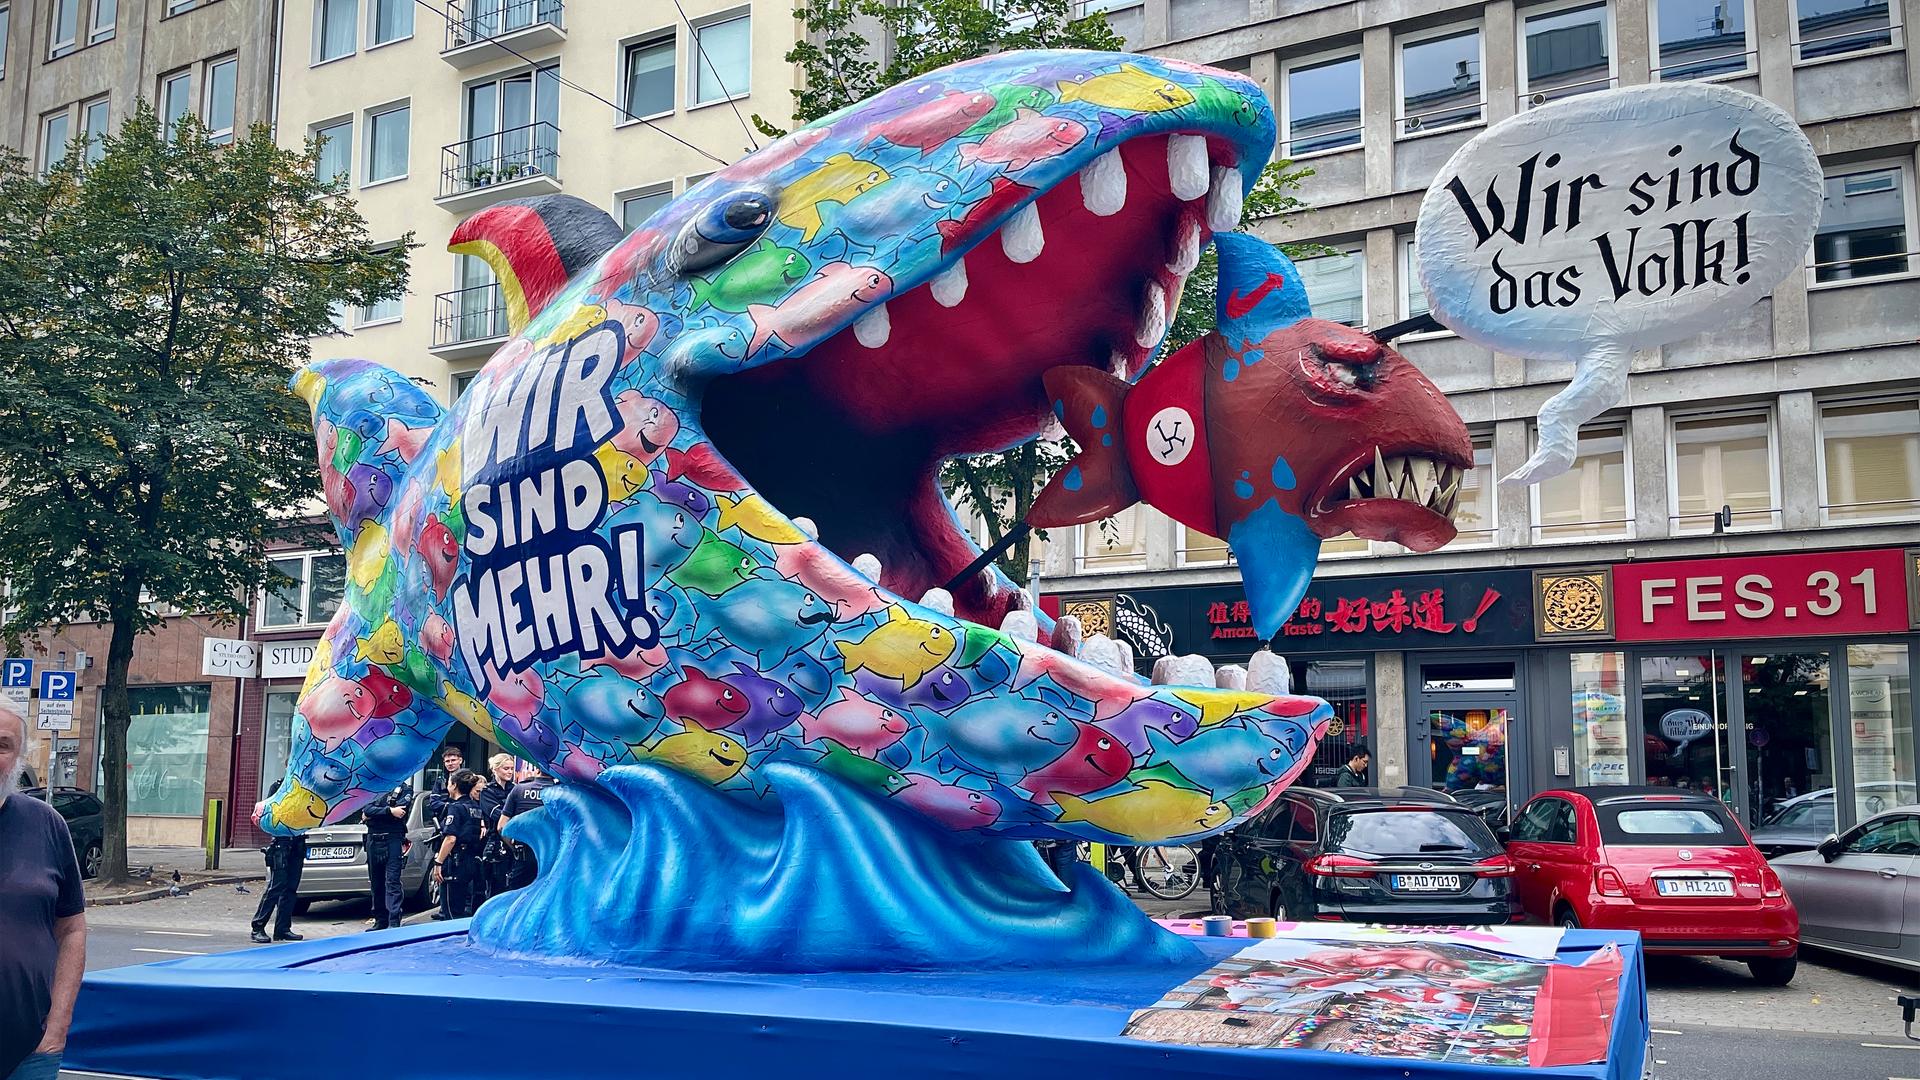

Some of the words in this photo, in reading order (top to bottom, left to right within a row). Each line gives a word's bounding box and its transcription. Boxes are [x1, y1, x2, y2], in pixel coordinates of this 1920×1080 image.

[1443, 150, 1609, 252] Wir
[1624, 127, 1760, 217] sind
[1488, 248, 1583, 315] das
[1589, 210, 1752, 304] Volk!
[462, 330, 614, 485] WIR
[465, 460, 602, 556] SIND
[454, 530, 654, 692] MEHR!
[1641, 568, 1877, 623] FES.31
[8, 662, 26, 686] P
[47, 674, 68, 699] P
[1399, 876, 1406, 887] B
[1670, 881, 1679, 892] D
